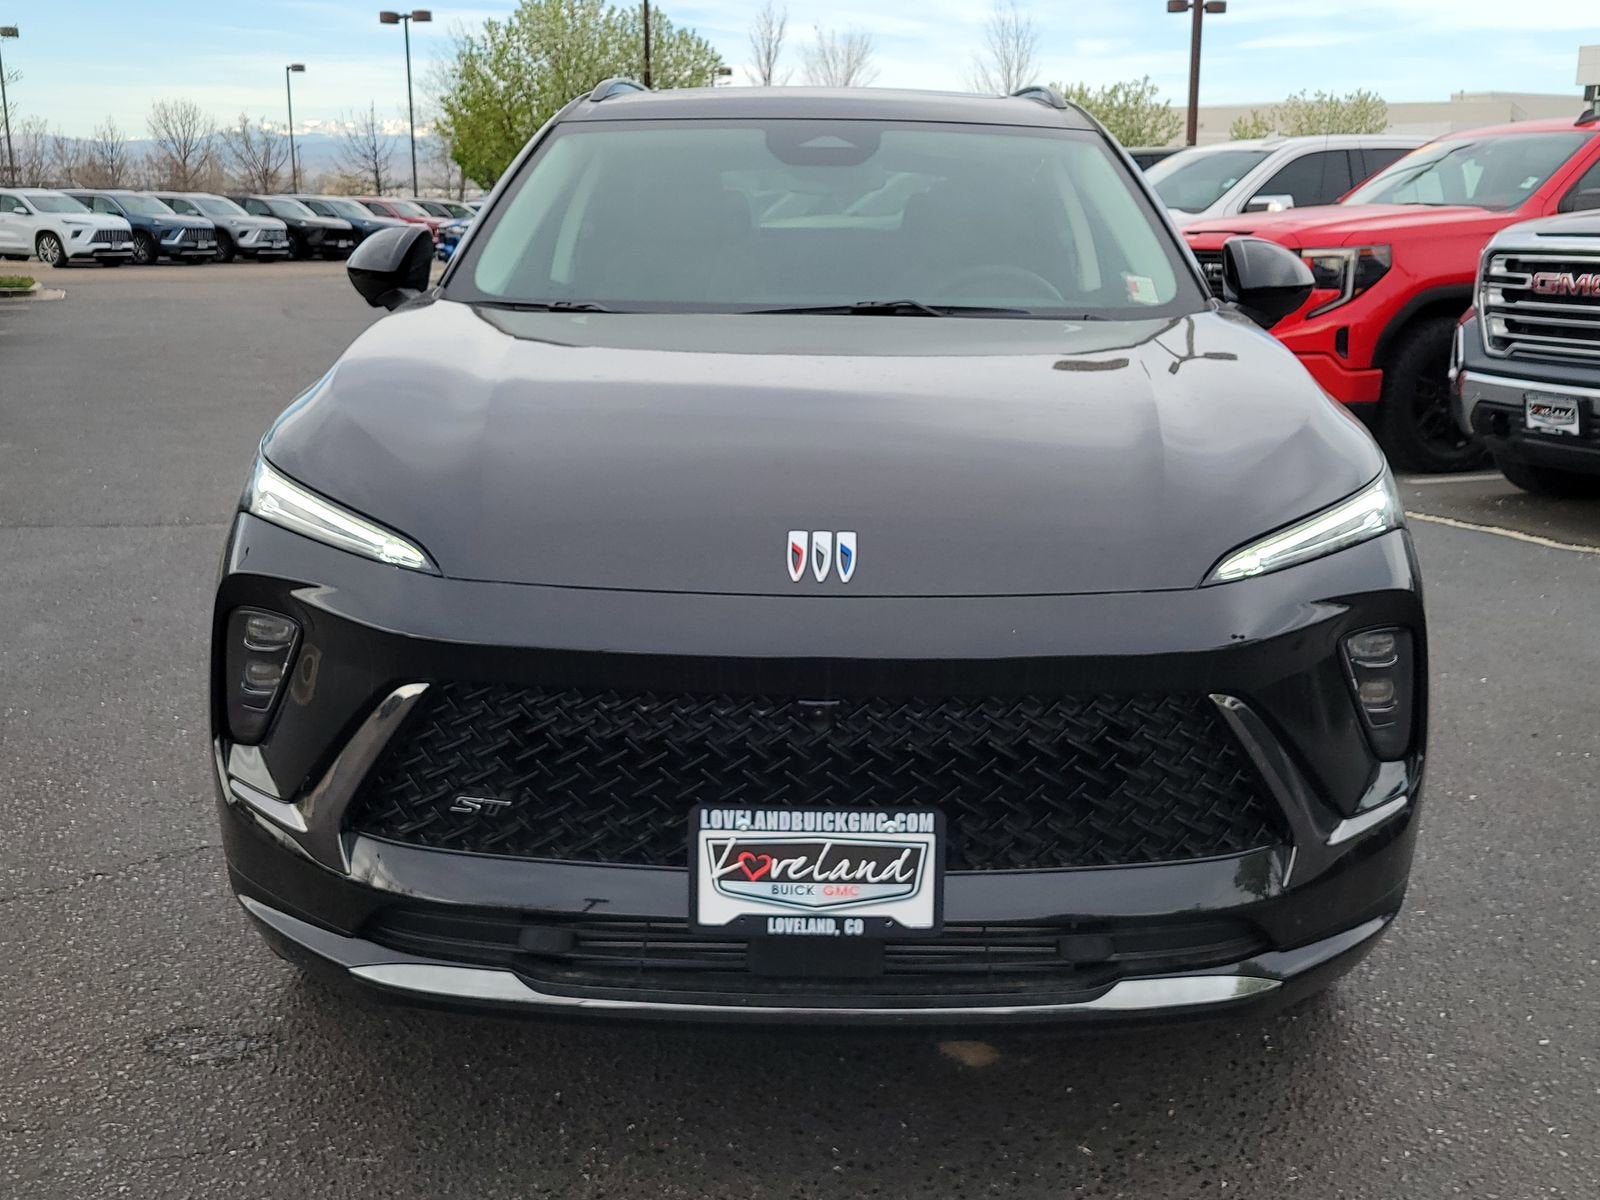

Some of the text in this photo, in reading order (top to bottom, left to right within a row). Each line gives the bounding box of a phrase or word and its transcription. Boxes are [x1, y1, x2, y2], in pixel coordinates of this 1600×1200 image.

[449, 796, 512, 816] ST
[771, 884, 860, 897] BUICK GMC
[767, 917, 864, 936] LOVELAND, CO
